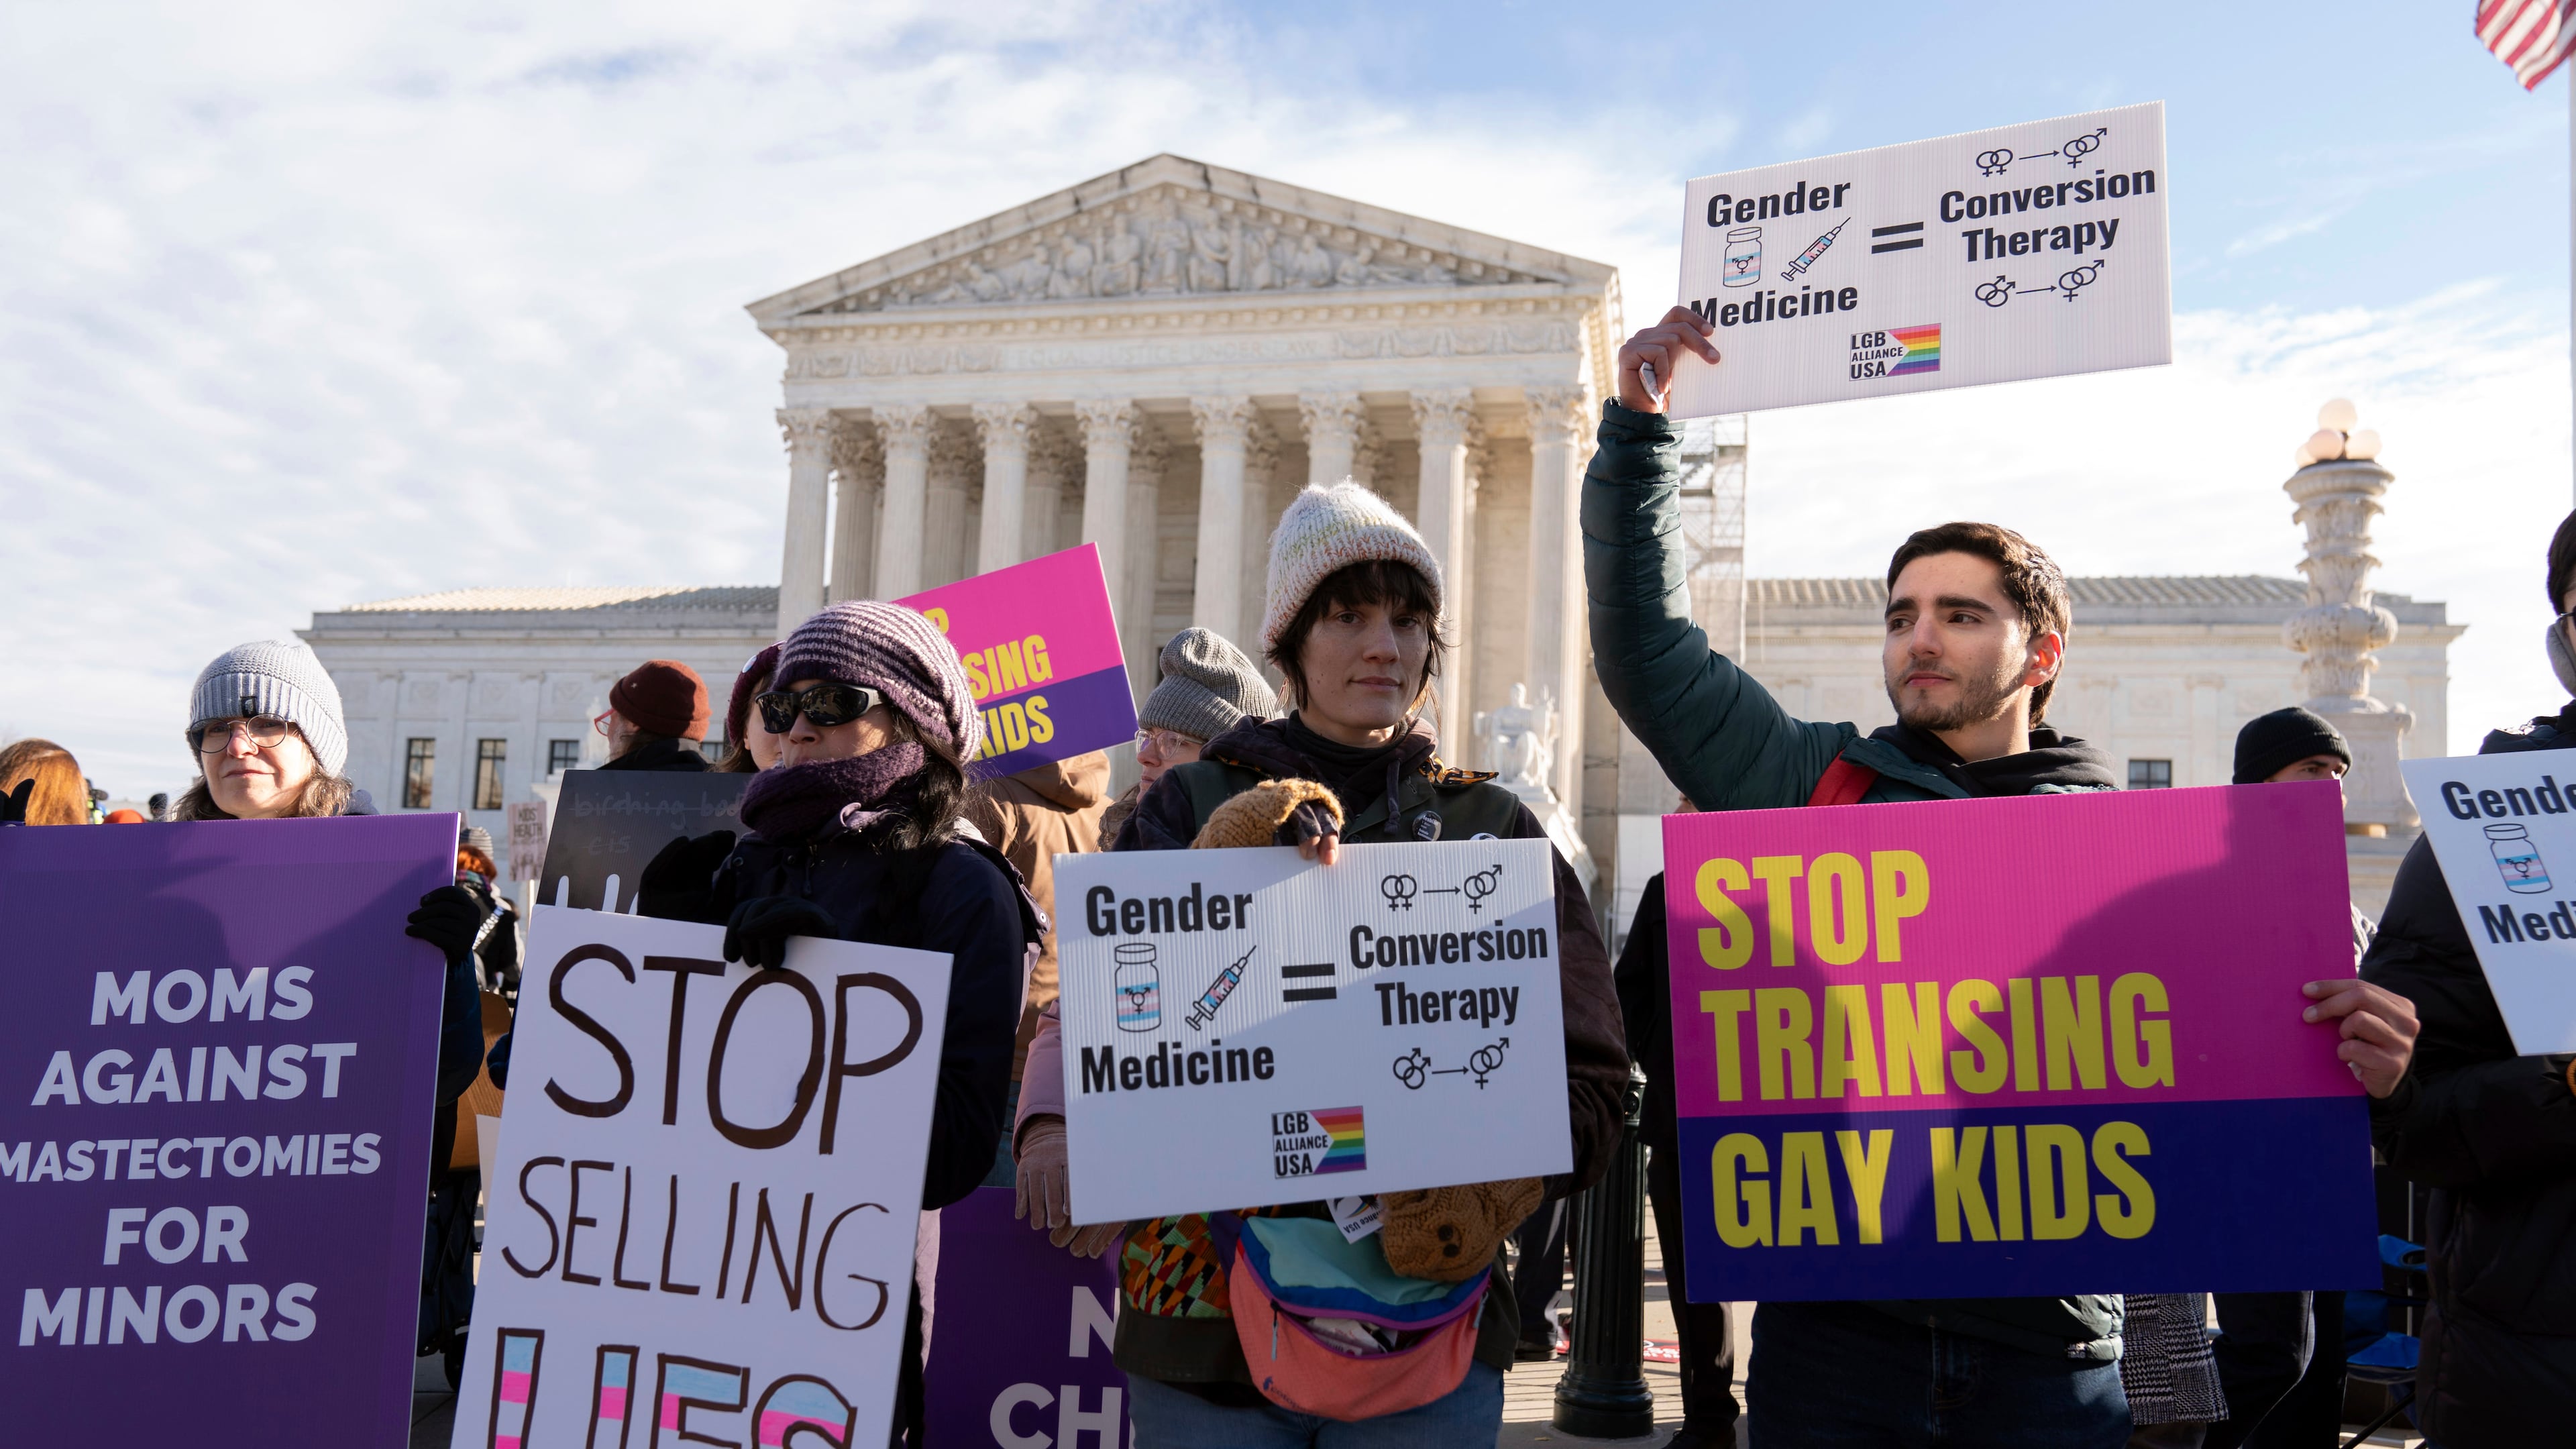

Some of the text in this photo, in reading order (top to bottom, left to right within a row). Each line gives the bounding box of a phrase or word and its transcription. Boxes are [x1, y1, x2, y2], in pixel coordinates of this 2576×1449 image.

[1707, 180, 1850, 227] Gender
[1941, 170, 2155, 222] Conversion
[1962, 218, 2119, 262] Therapy
[1688, 286, 1857, 329] Medicine
[1851, 331, 1886, 350] LGB
[1851, 347, 1902, 362] ALLIANCE
[1851, 362, 1886, 379] USA
[1086, 883, 1252, 936] Gender
[1696, 851, 1929, 969] STOP
[1350, 920, 1548, 969] Conversion
[91, 966, 314, 1025] MOMS
[1375, 982, 1519, 1028] Therapy
[545, 944, 922, 1155] STOP
[1701, 973, 2174, 1101] TRANSING
[32, 1043, 357, 1106] AGAINST
[1081, 1039, 1274, 1093] Medicine
[1274, 1112, 1309, 1135] LGB
[1276, 1135, 1328, 1152] ALLIANCE
[0, 1133, 381, 1182] MASTECTOMIES
[1276, 1154, 1312, 1177] USA
[1713, 1122, 2155, 1247] GAY KIDS
[103, 1206, 249, 1265] FOR
[502, 1157, 889, 1330] SELLING
[1343, 1221, 1360, 1234] USA
[19, 1283, 317, 1346] MINORS
[990, 1383, 1136, 1449] CH
